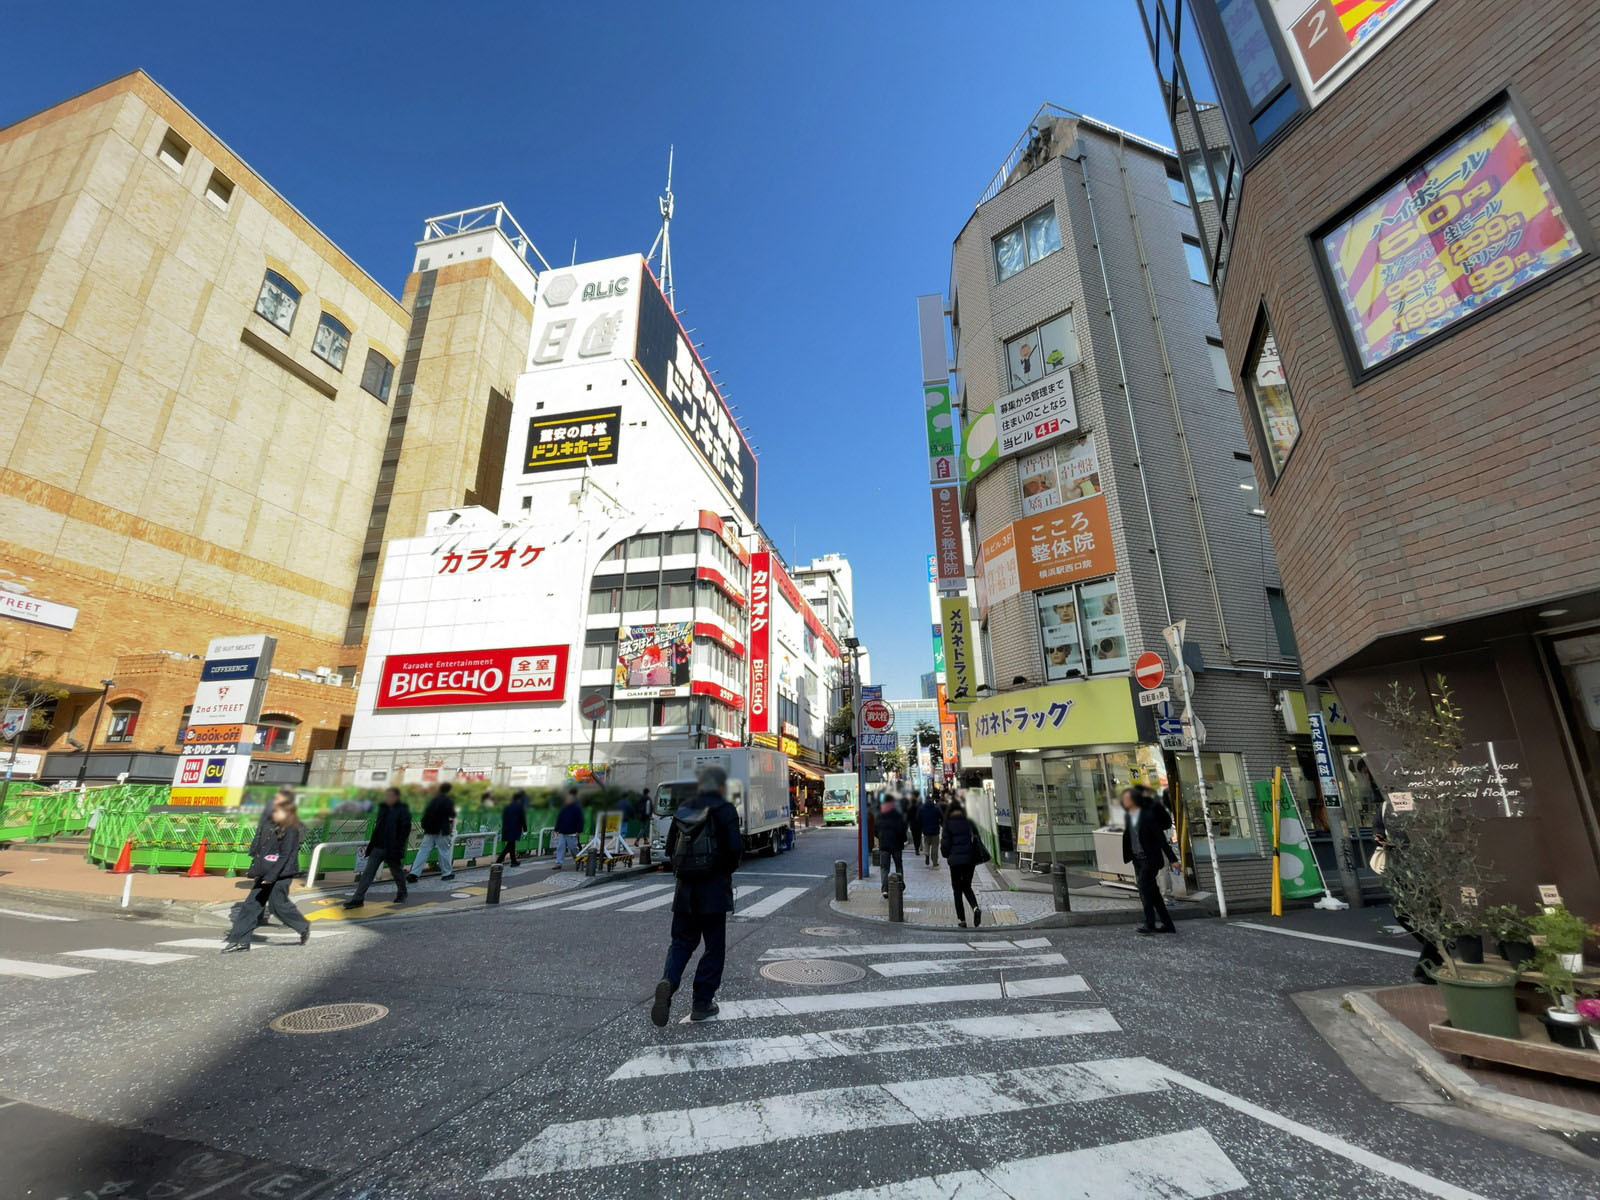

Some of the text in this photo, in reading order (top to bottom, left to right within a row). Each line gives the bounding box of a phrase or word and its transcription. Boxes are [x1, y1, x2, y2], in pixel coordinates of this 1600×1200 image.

[1308, 9, 1328, 49] 2
[1443, 199, 1503, 244] 生ビール
[1450, 213, 1522, 265] 299円
[1461, 230, 1523, 275] ドリンク
[1000, 379, 1065, 415] 募集から管理まで
[1002, 397, 1067, 431] 住まいのことなら
[941, 502, 959, 577] こころ整体院
[1031, 511, 1090, 542] こころ
[438, 544, 546, 575] カラオケ
[1030, 532, 1096, 564] 整体院
[751, 570, 769, 631] カラオケ
[211, 664, 249, 673] DIFFERENCE
[403, 658, 494, 670] Karaoke Entertainment
[517, 659, 550, 672] 全室
[949, 608, 969, 700] メガネドラッグ
[388, 667, 503, 698] BIG ECHO
[511, 677, 551, 689] DAM
[752, 659, 764, 715] BIG ECHO
[196, 703, 244, 713] 2nd STREET
[866, 710, 888, 723] 消火栓
[975, 699, 1074, 738] メガネドラッグ
[183, 771, 200, 781] QLO
[185, 762, 201, 770] UNI
[206, 764, 225, 778] GU
